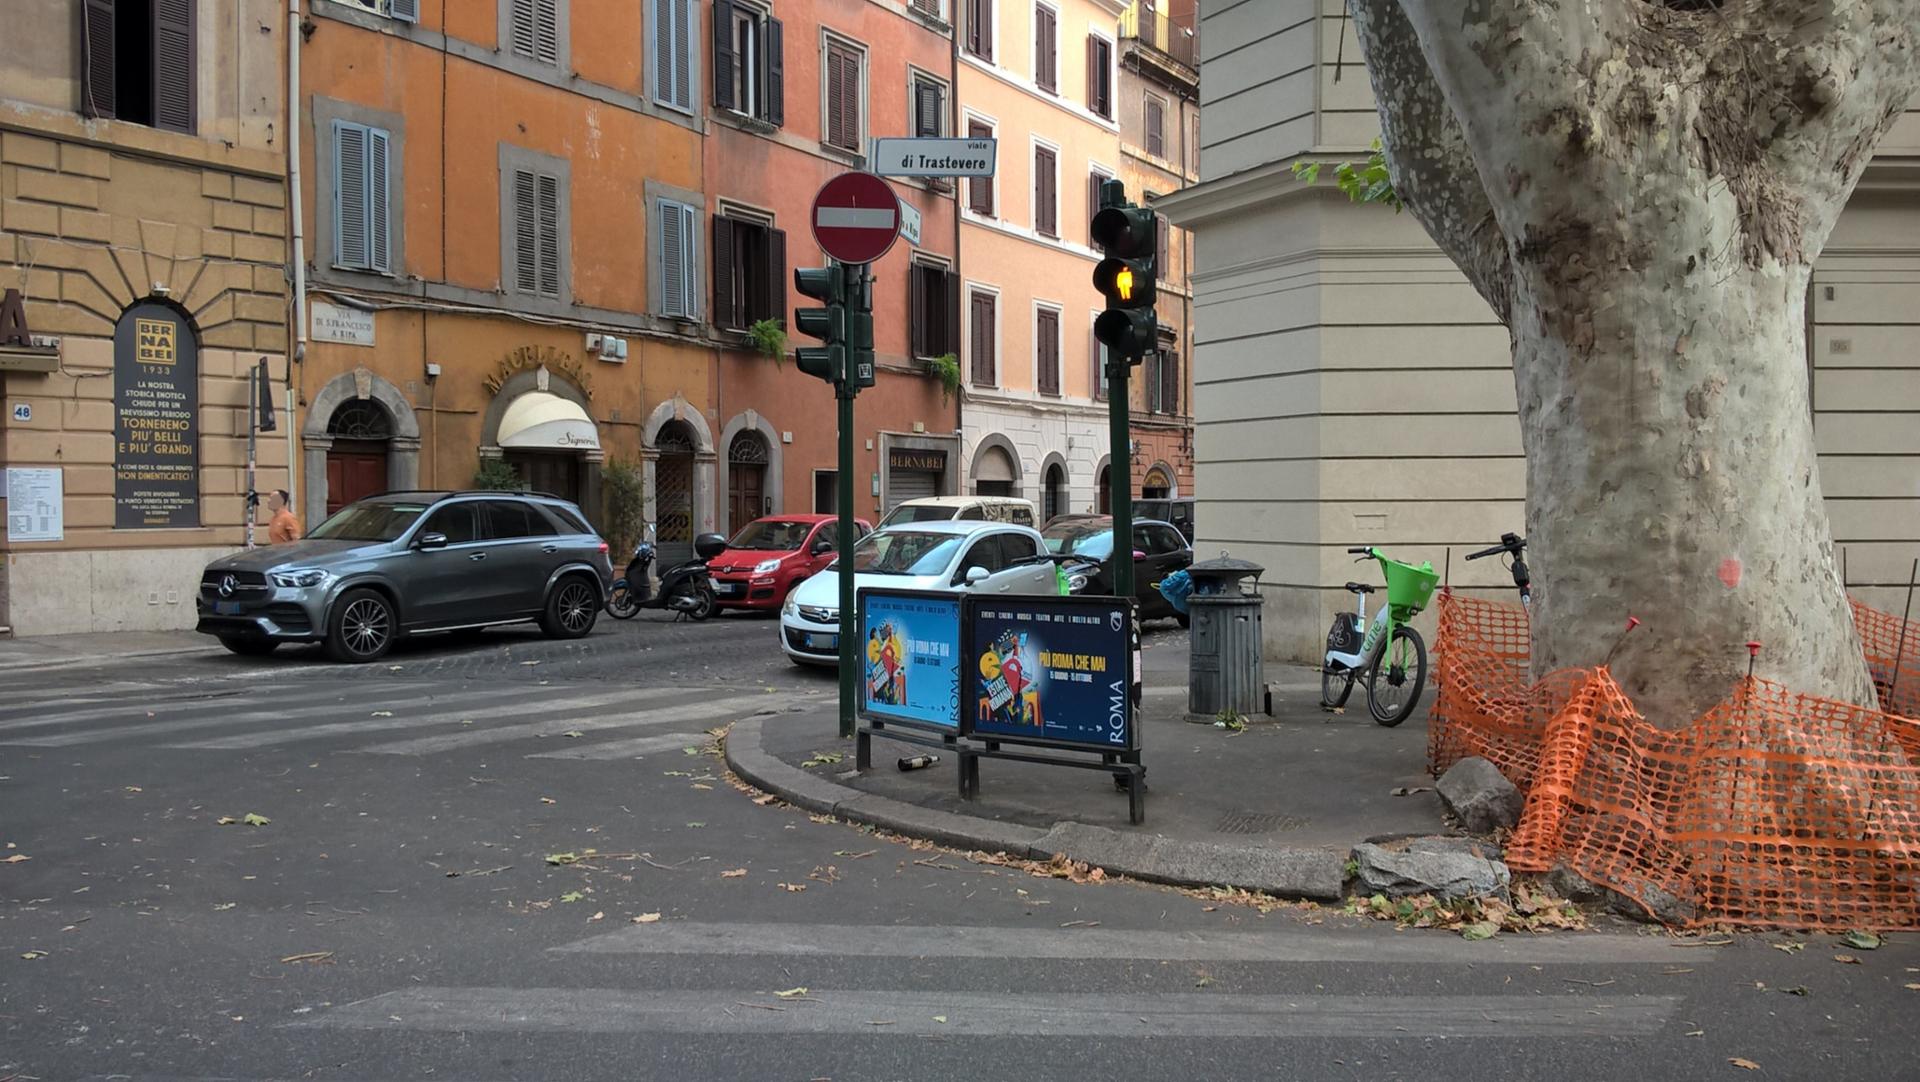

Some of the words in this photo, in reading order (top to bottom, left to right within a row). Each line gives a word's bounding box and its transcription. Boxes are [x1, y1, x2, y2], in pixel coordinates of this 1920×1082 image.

[902, 155, 912, 168] di
[920, 155, 986, 169] Trastevere
[0, 288, 32, 346] A
[337, 310, 351, 319] VIA
[141, 324, 171, 335] BER
[340, 330, 356, 339] RIPA
[141, 336, 170, 347] NA
[141, 349, 172, 359] BEI
[144, 366, 170, 375] 1933
[16, 408, 30, 417] 48
[120, 409, 160, 417] BREVISSIMO
[122, 418, 190, 430] TORNEREMO
[132, 431, 151, 441] PIU'
[155, 432, 180, 442] BELLI
[120, 443, 125, 452] E
[130, 443, 151, 453] PIU'
[154, 444, 192, 454] GRANDI
[891, 455, 943, 469] BERNABEI
[1040, 649, 1050, 667] PIÙ
[1052, 653, 1074, 669] ROMA
[1075, 655, 1089, 670] CHE
[1091, 656, 1105, 672] MAI
[950, 664, 960, 721] ROMA
[1110, 680, 1123, 743] ROMA
